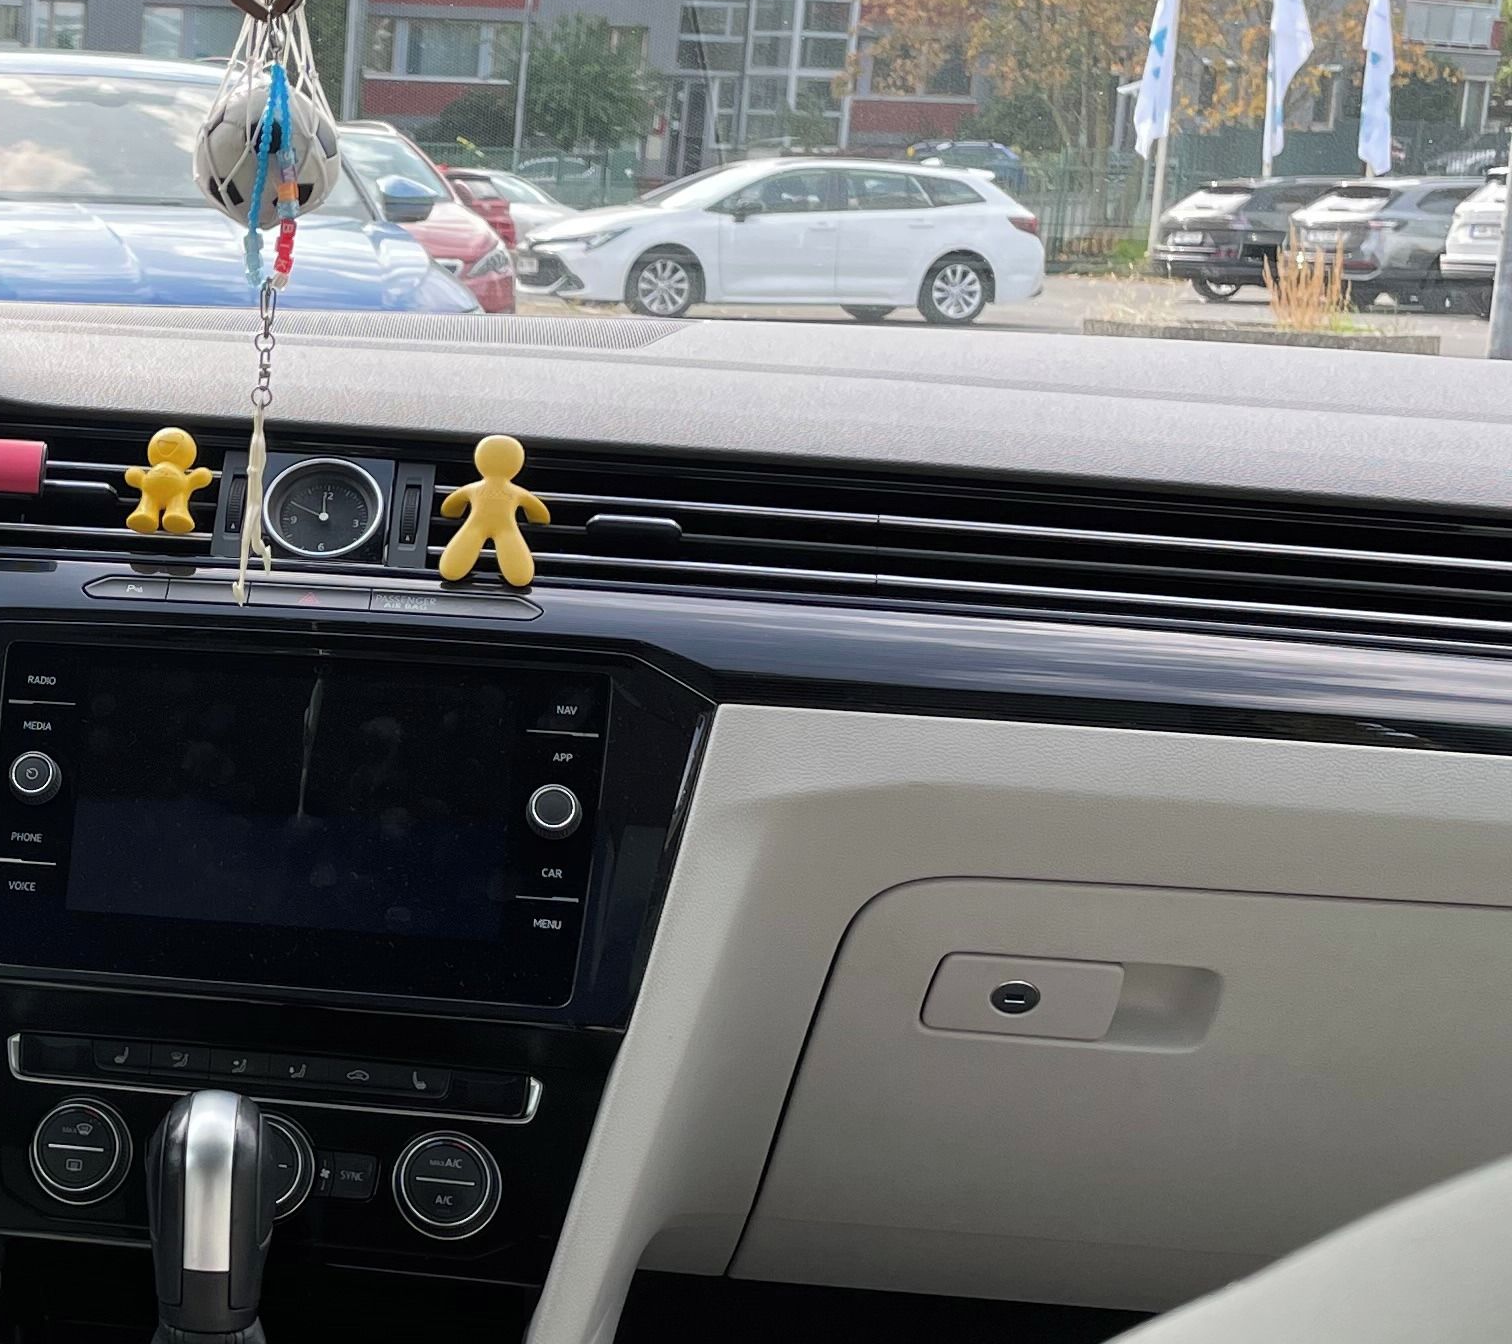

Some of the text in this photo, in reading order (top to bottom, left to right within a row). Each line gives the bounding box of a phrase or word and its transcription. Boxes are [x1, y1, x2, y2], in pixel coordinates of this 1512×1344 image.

[352, 519, 360, 528] 3
[317, 543, 326, 552] 6
[375, 594, 437, 606] PASSENGER
[27, 675, 57, 686] RADIO
[556, 705, 578, 716] NAV
[23, 720, 52, 731] MEDIA
[552, 752, 574, 763] APP
[10, 831, 44, 843] PHONE
[541, 867, 563, 879] CAR
[8, 880, 37, 892] VOICE
[533, 918, 563, 930] MENU
[444, 1158, 464, 1169] A/C
[339, 1170, 365, 1182] SYNC
[435, 1195, 454, 1206] A/C
